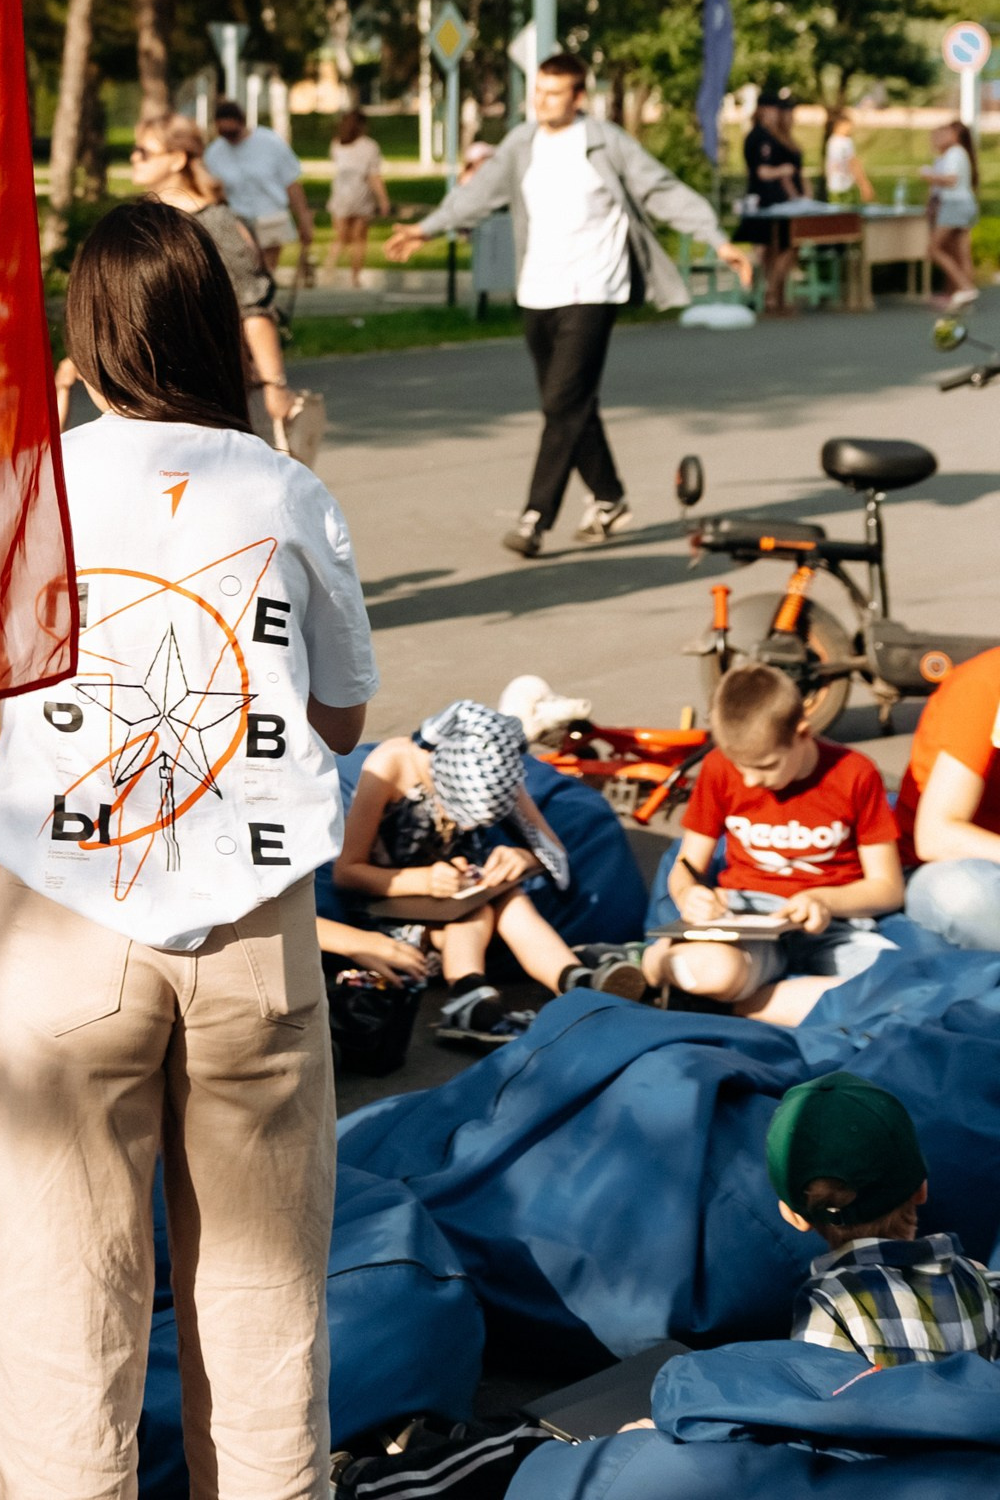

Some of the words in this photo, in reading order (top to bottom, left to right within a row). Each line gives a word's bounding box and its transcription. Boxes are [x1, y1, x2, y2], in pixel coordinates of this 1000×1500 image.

[252, 596, 291, 647] Е
[246, 713, 287, 759] В
[51, 794, 112, 845] Ы
[248, 822, 291, 866] Е
